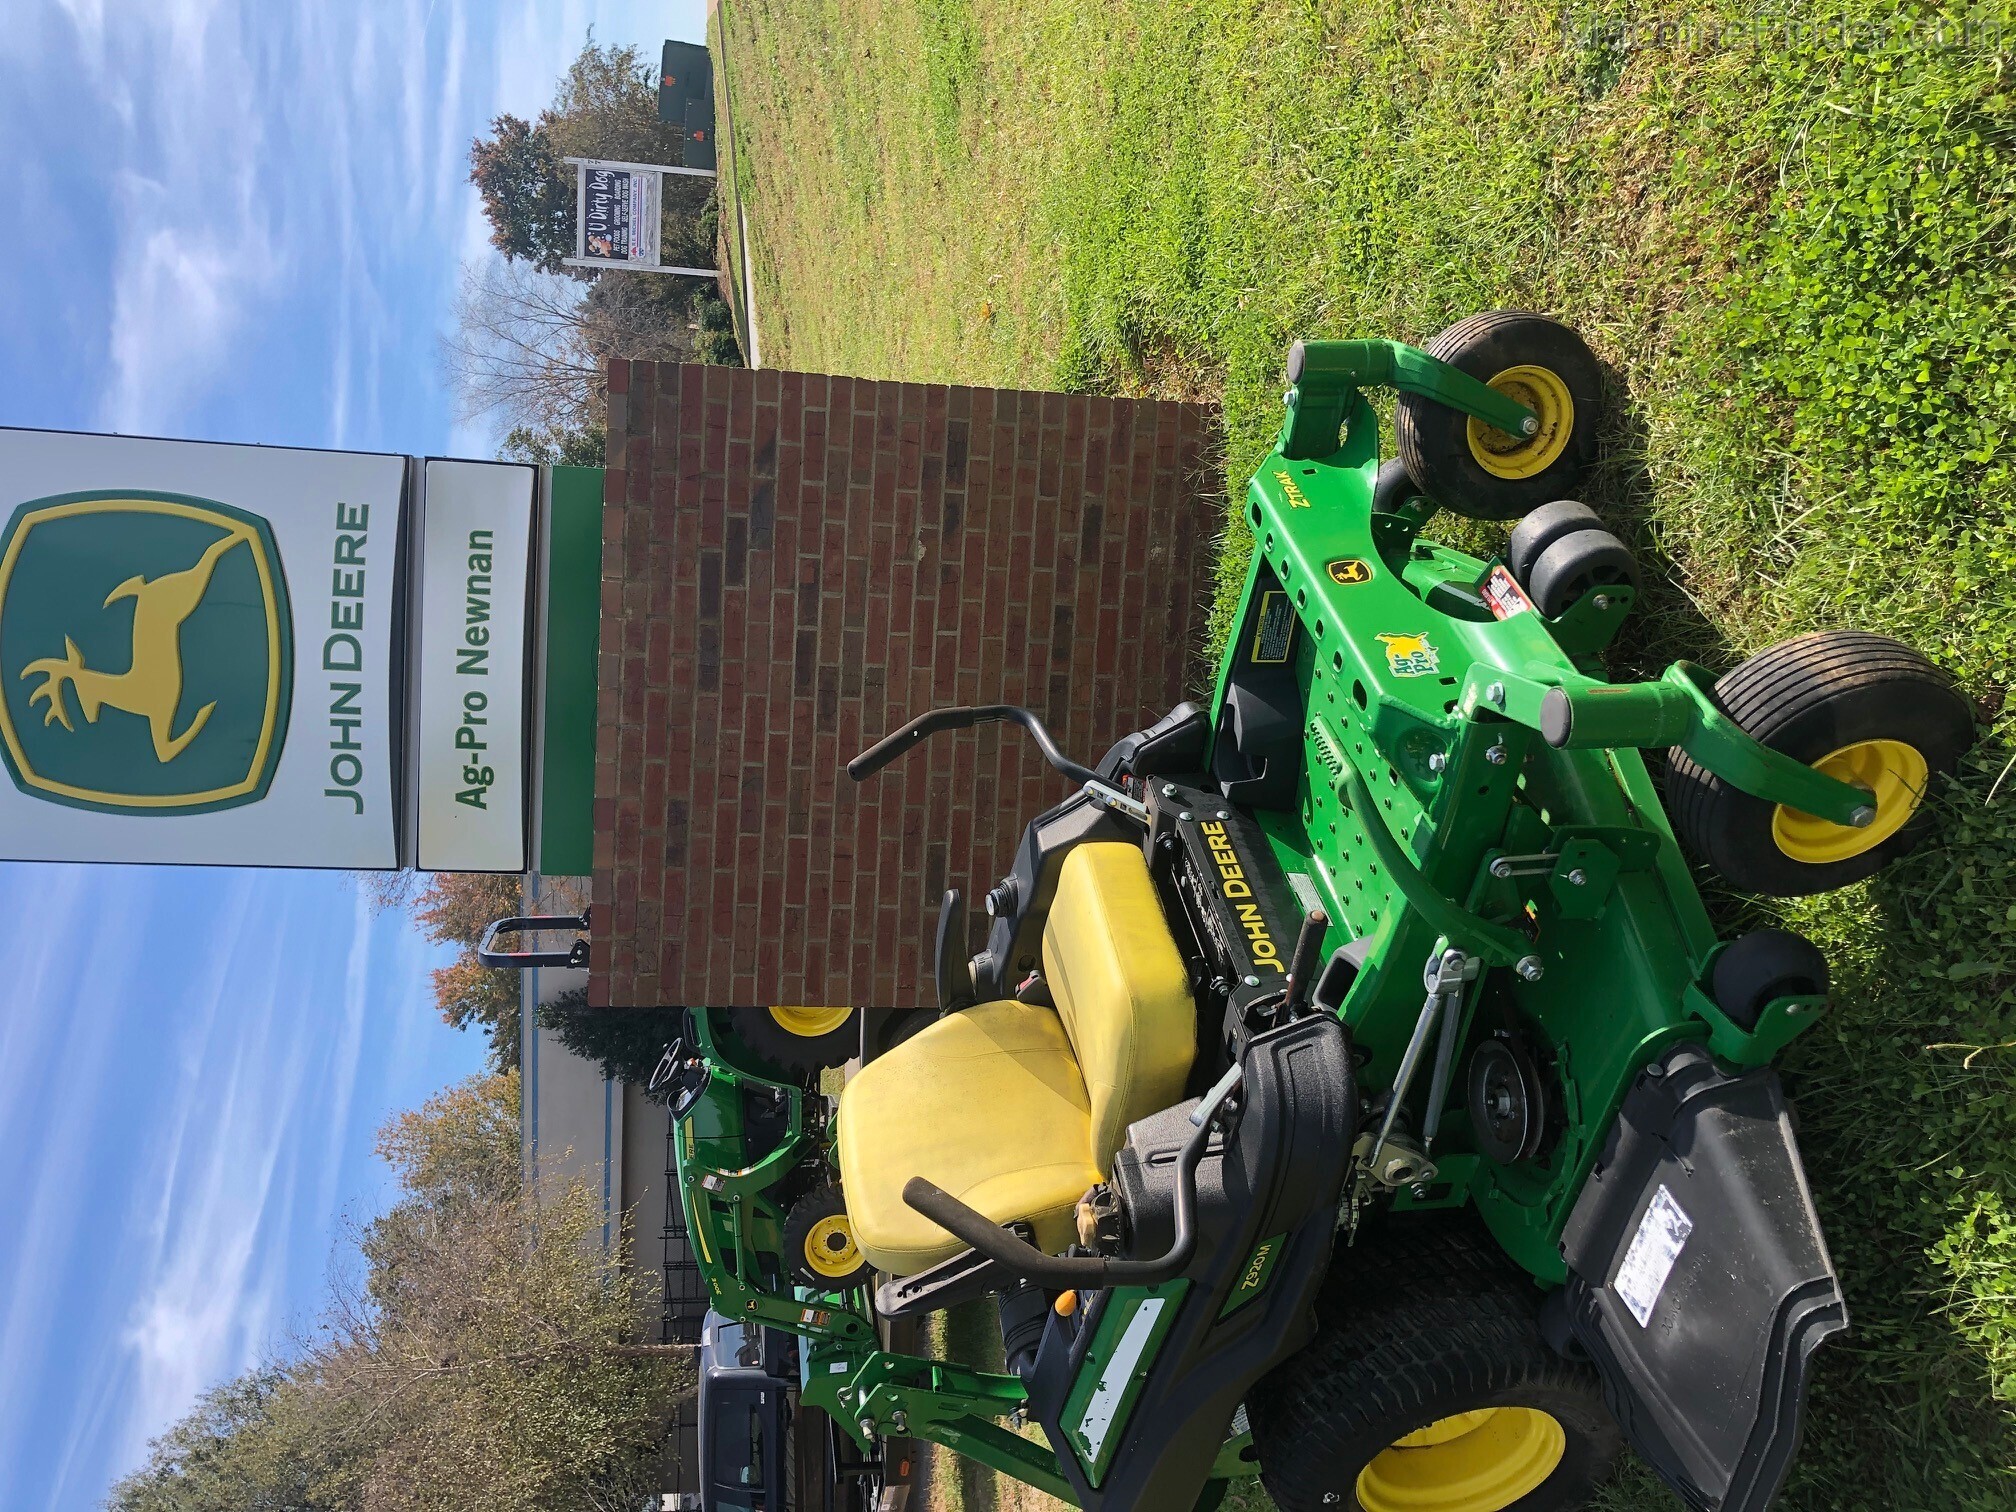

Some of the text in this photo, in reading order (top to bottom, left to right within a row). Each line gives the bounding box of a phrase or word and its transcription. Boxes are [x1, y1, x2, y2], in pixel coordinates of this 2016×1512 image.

[587, 170, 615, 231] U Dirty Dog
[614, 179, 622, 200] BOARDING
[613, 229, 621, 243] FOODS
[1272, 469, 1311, 509] ZTRAK
[322, 503, 369, 815] JOHN DEERE
[454, 528, 496, 811] Ag-Pro Newnan
[1393, 654, 1415, 674] Ag-
[1411, 651, 1434, 673] Pro
[1201, 820, 1285, 973] JOHN DEERE
[1240, 1244, 1272, 1290] Z920M
